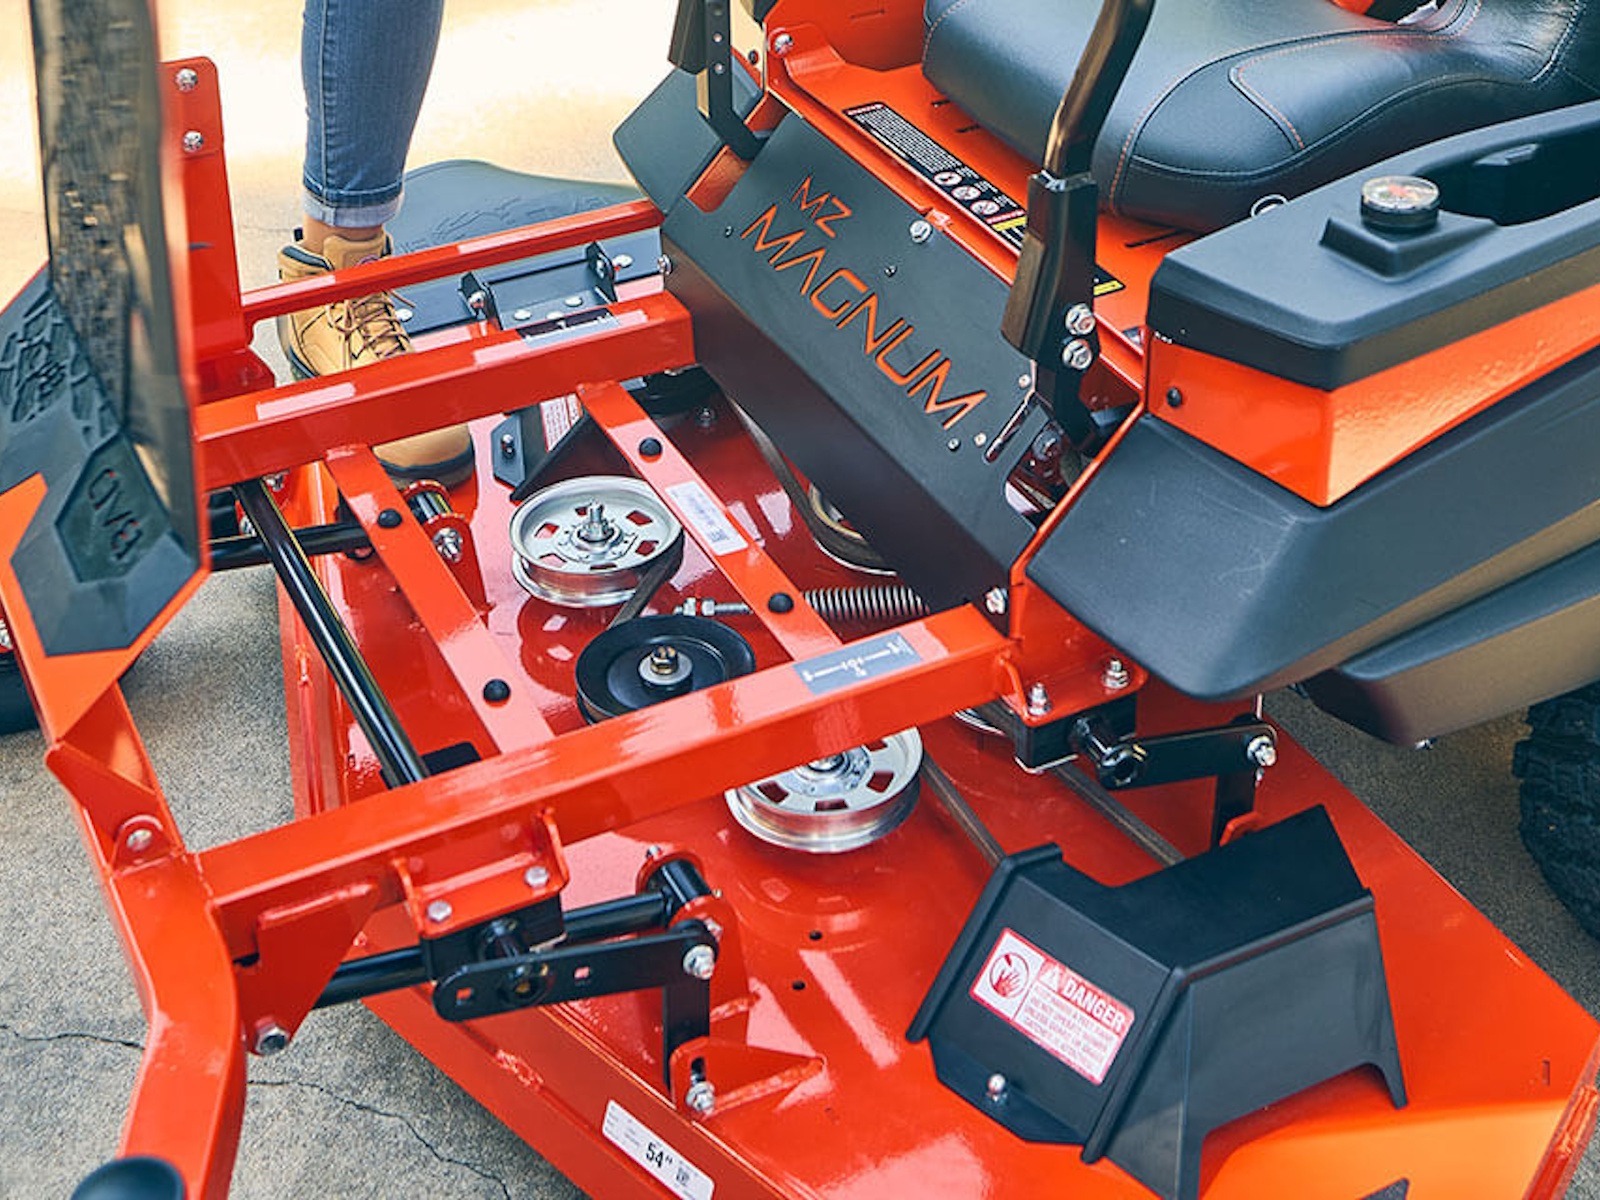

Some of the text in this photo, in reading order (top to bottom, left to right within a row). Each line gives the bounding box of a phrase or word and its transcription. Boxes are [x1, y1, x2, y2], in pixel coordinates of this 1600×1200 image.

[791, 176, 854, 239] MZ
[740, 204, 988, 430] MAGNUM
[1063, 977, 1126, 1033] DANGER
[645, 1142, 673, 1168] 54"
